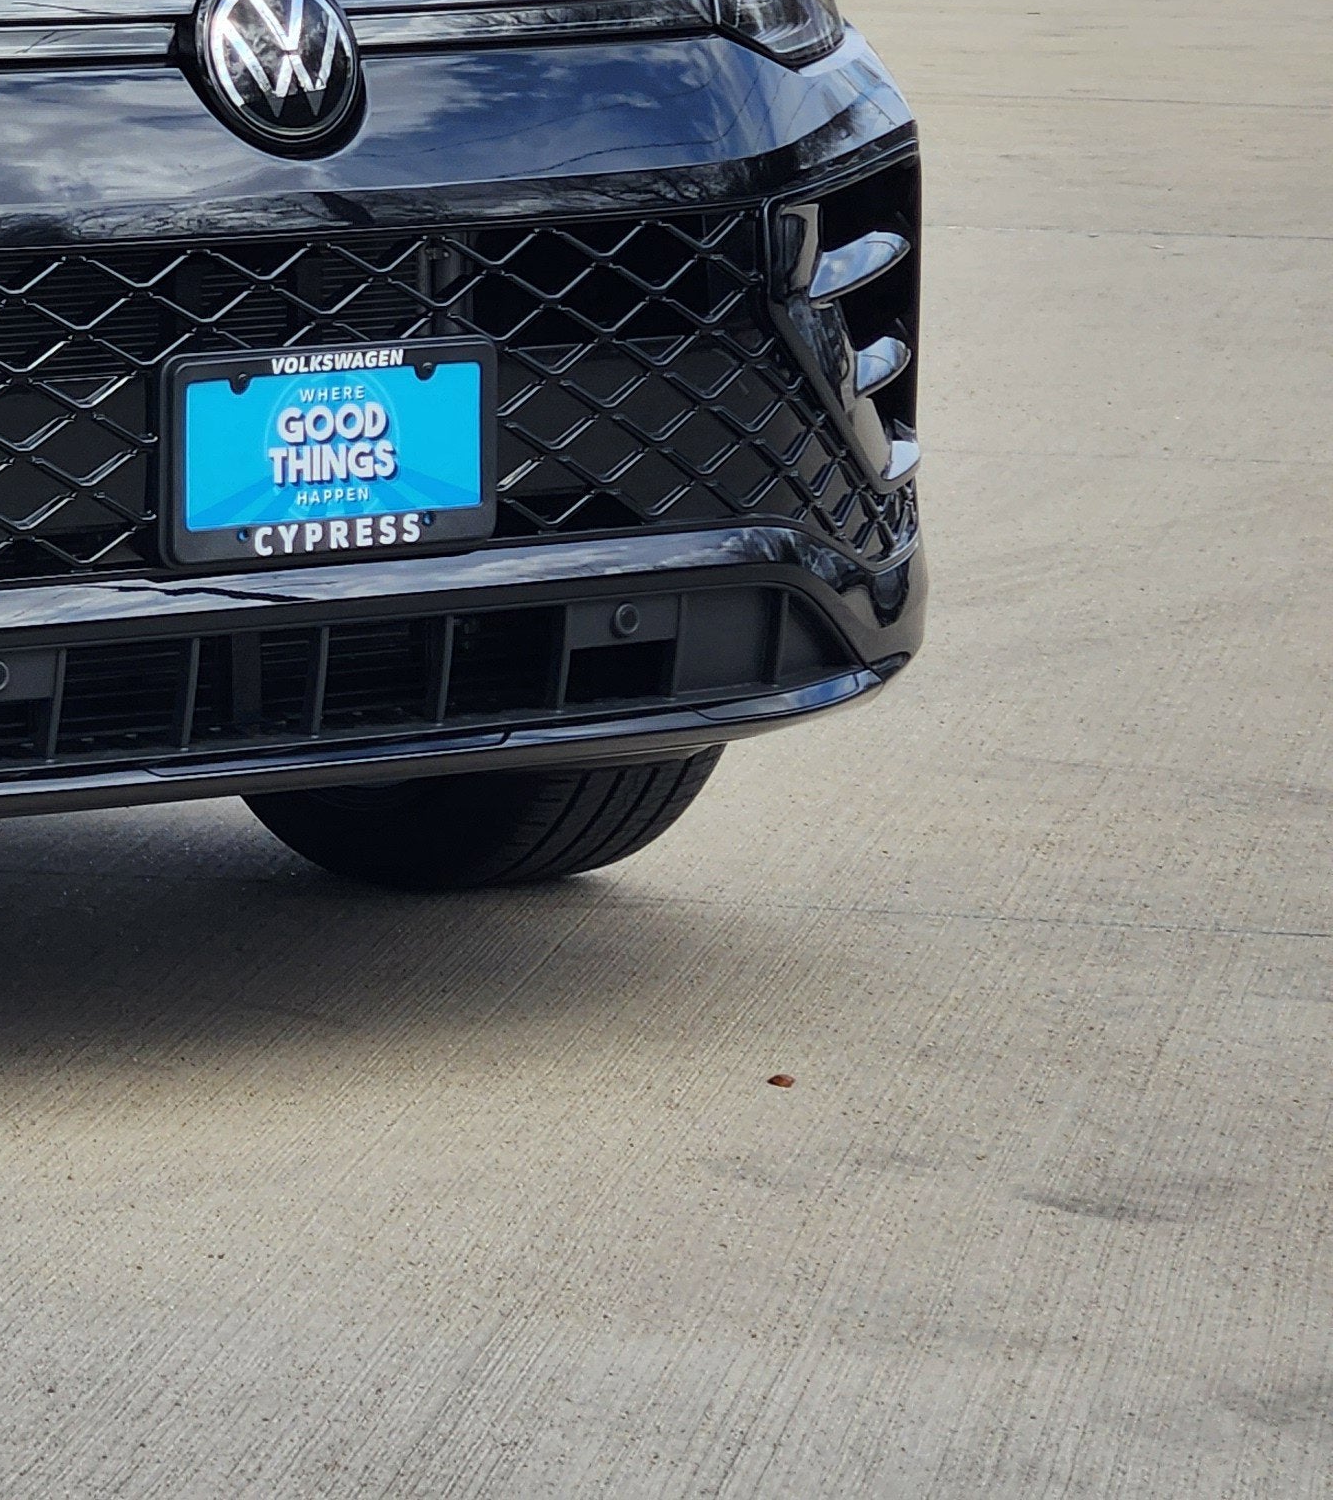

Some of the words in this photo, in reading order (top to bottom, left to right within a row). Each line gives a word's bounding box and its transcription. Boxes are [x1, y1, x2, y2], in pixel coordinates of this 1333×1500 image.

[271, 348, 405, 376] VOLKSWAGEN
[299, 385, 366, 403] WHERE
[276, 401, 389, 444] GOOD
[267, 440, 397, 485] THINGS
[296, 487, 371, 506] HAPPEN
[253, 512, 422, 557] CYPRESS
